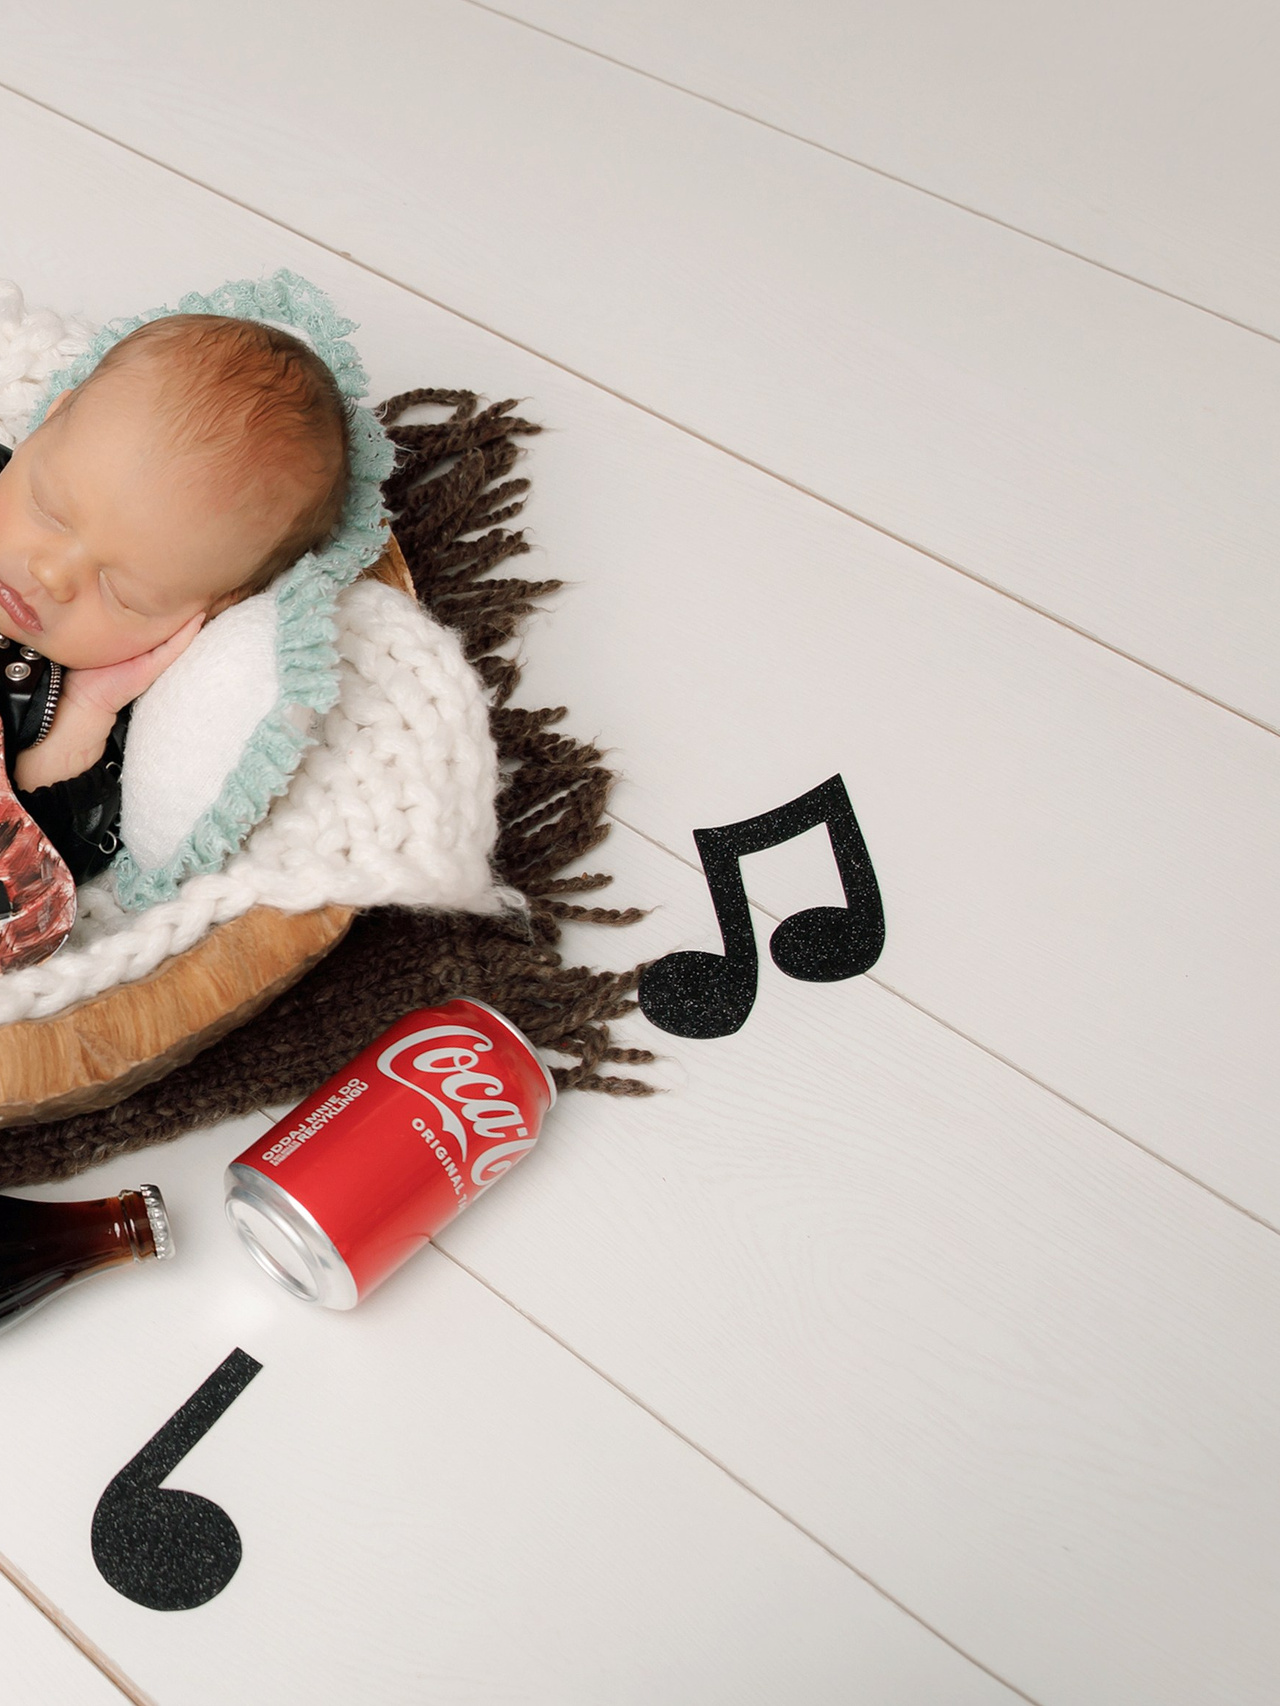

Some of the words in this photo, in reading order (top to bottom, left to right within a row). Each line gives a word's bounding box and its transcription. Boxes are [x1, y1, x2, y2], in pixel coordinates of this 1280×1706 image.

[262, 1123, 307, 1161] ODDAJ
[304, 1095, 341, 1124] MNIE
[338, 1078, 360, 1096] DO
[296, 1082, 369, 1143] RECYKLINGU
[377, 1025, 538, 1200] Coca-C
[411, 1117, 465, 1196] ORIGINAL
